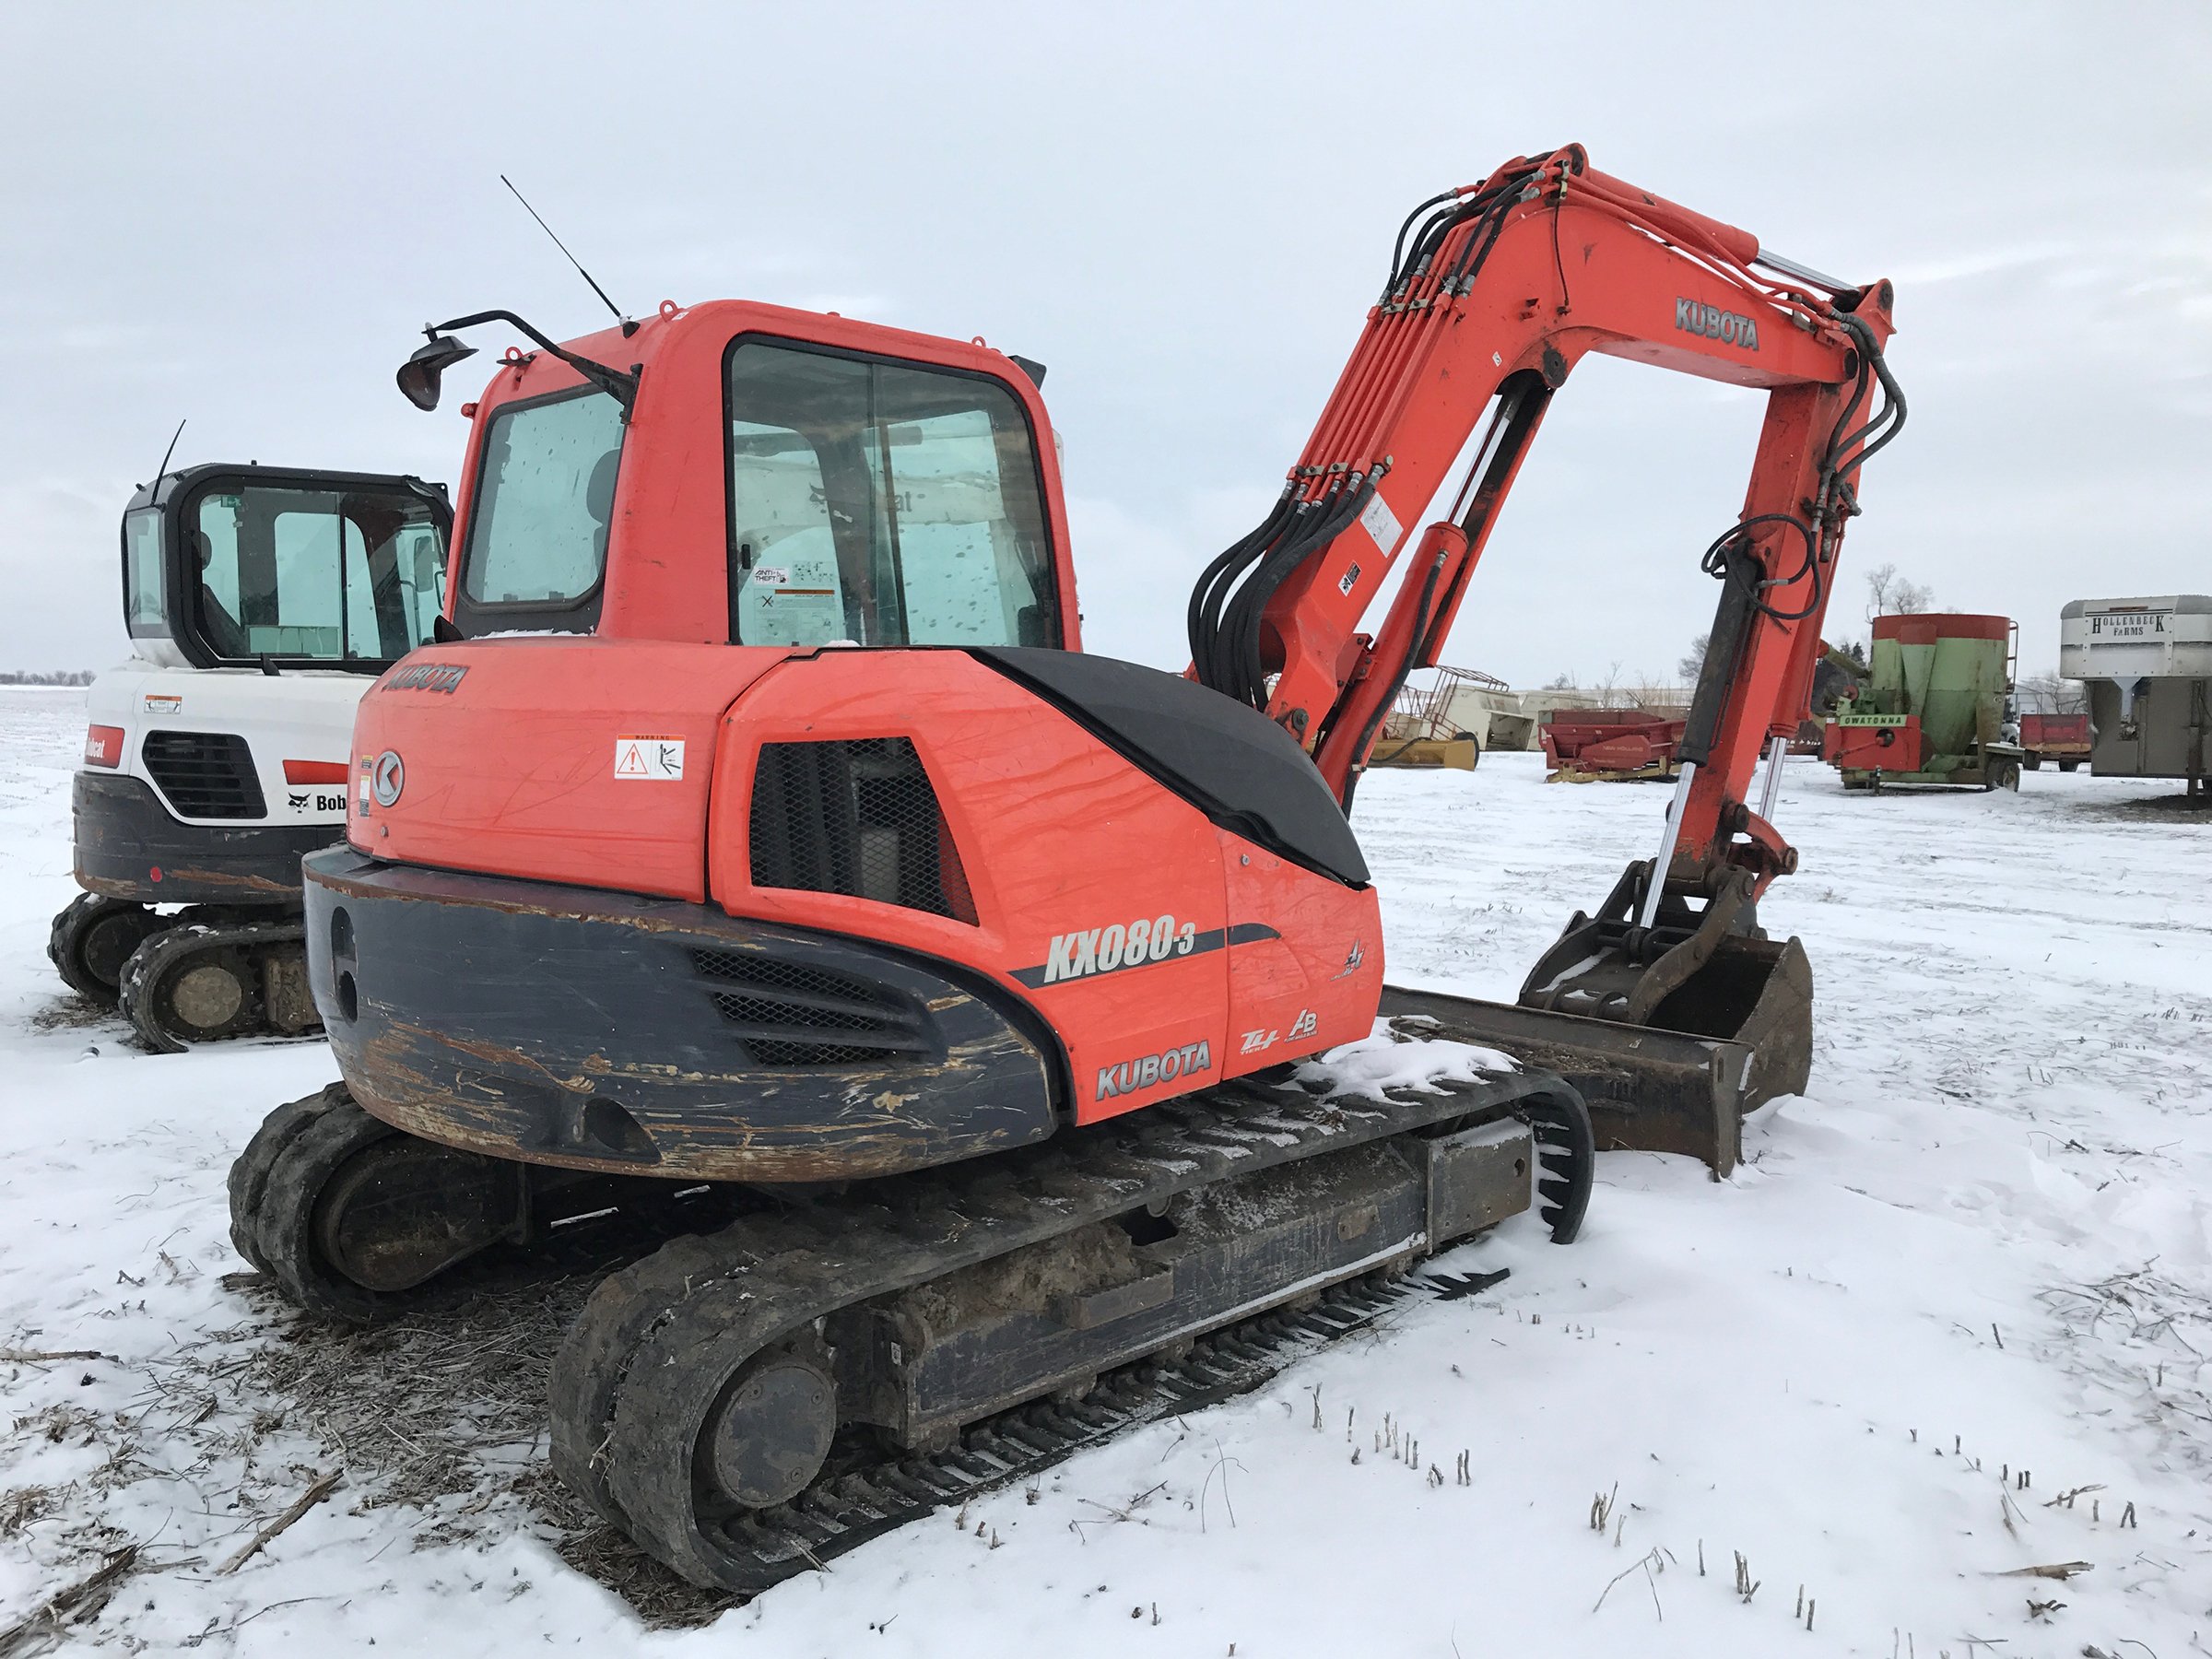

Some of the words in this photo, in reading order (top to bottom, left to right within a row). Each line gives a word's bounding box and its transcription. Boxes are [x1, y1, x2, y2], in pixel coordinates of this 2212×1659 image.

[1676, 296, 1759, 351] KUBOTA
[2091, 615, 2165, 634] HOLLENBECK
[2113, 627, 2144, 636] FARMS
[381, 663, 471, 693] KUBOTA
[1844, 716, 1901, 724] OWATONNA
[1095, 1039, 1211, 1102] KUBOTA
